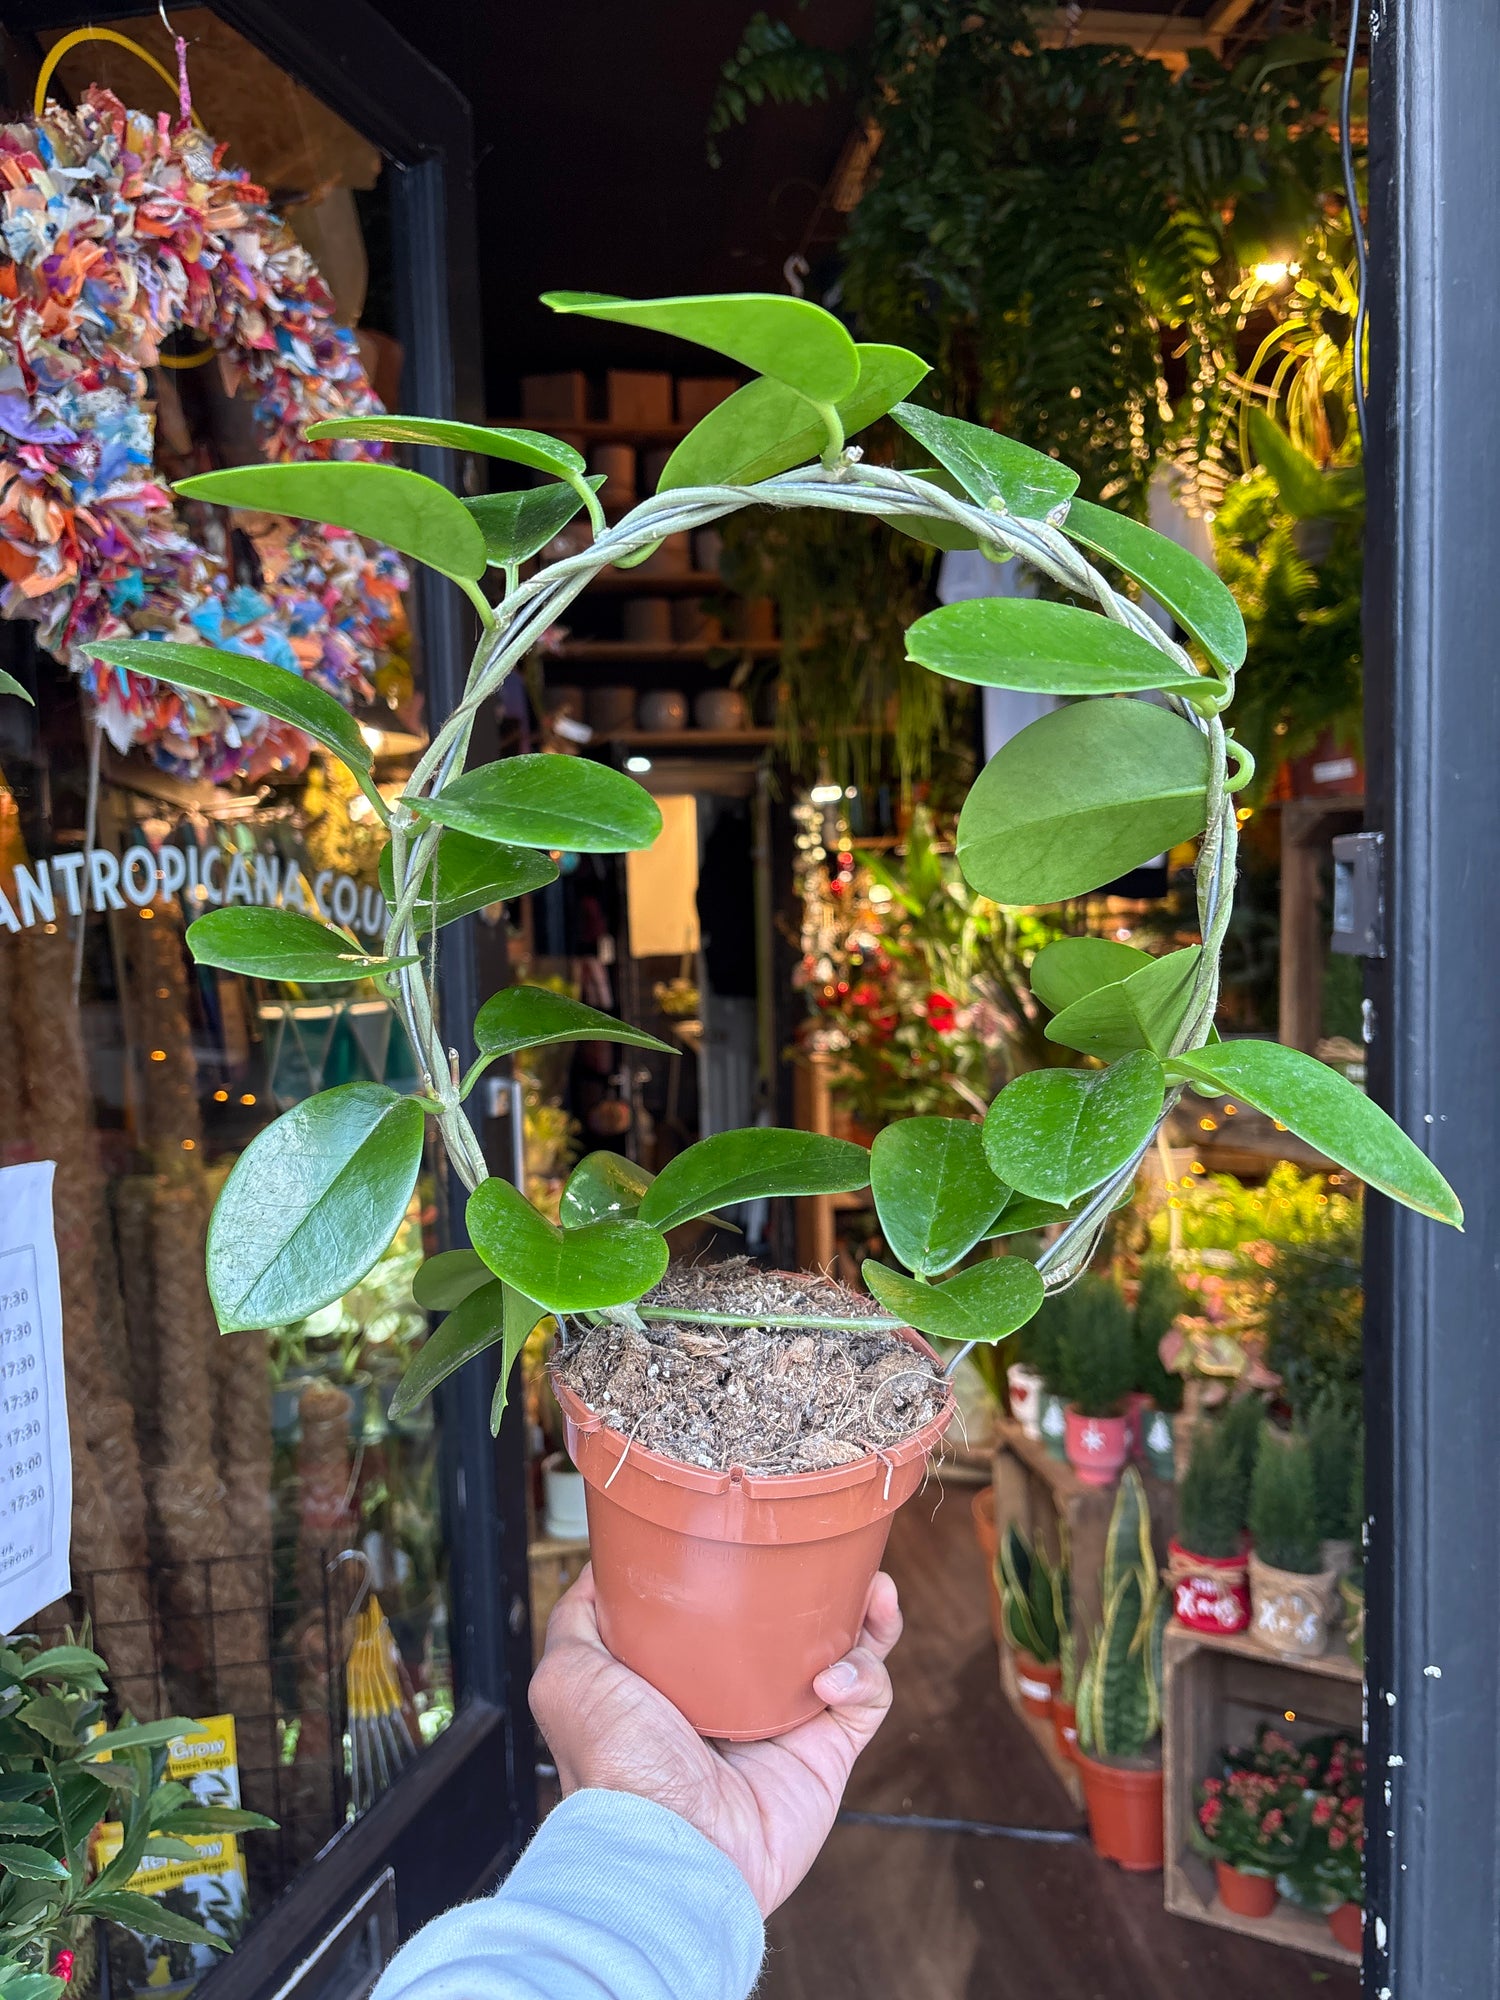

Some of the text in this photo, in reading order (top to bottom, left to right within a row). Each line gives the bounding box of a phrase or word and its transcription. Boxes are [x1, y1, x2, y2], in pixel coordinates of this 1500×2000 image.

[0, 1288, 28, 1311] 7:30
[1, 1354, 35, 1379] 17:30
[3, 1387, 39, 1414] 17:30
[7, 1420, 41, 1447] 17:30
[8, 1452, 42, 1480] 18:00
[9, 1485, 45, 1514] 17:30
[169, 1740, 225, 1760] Grow
